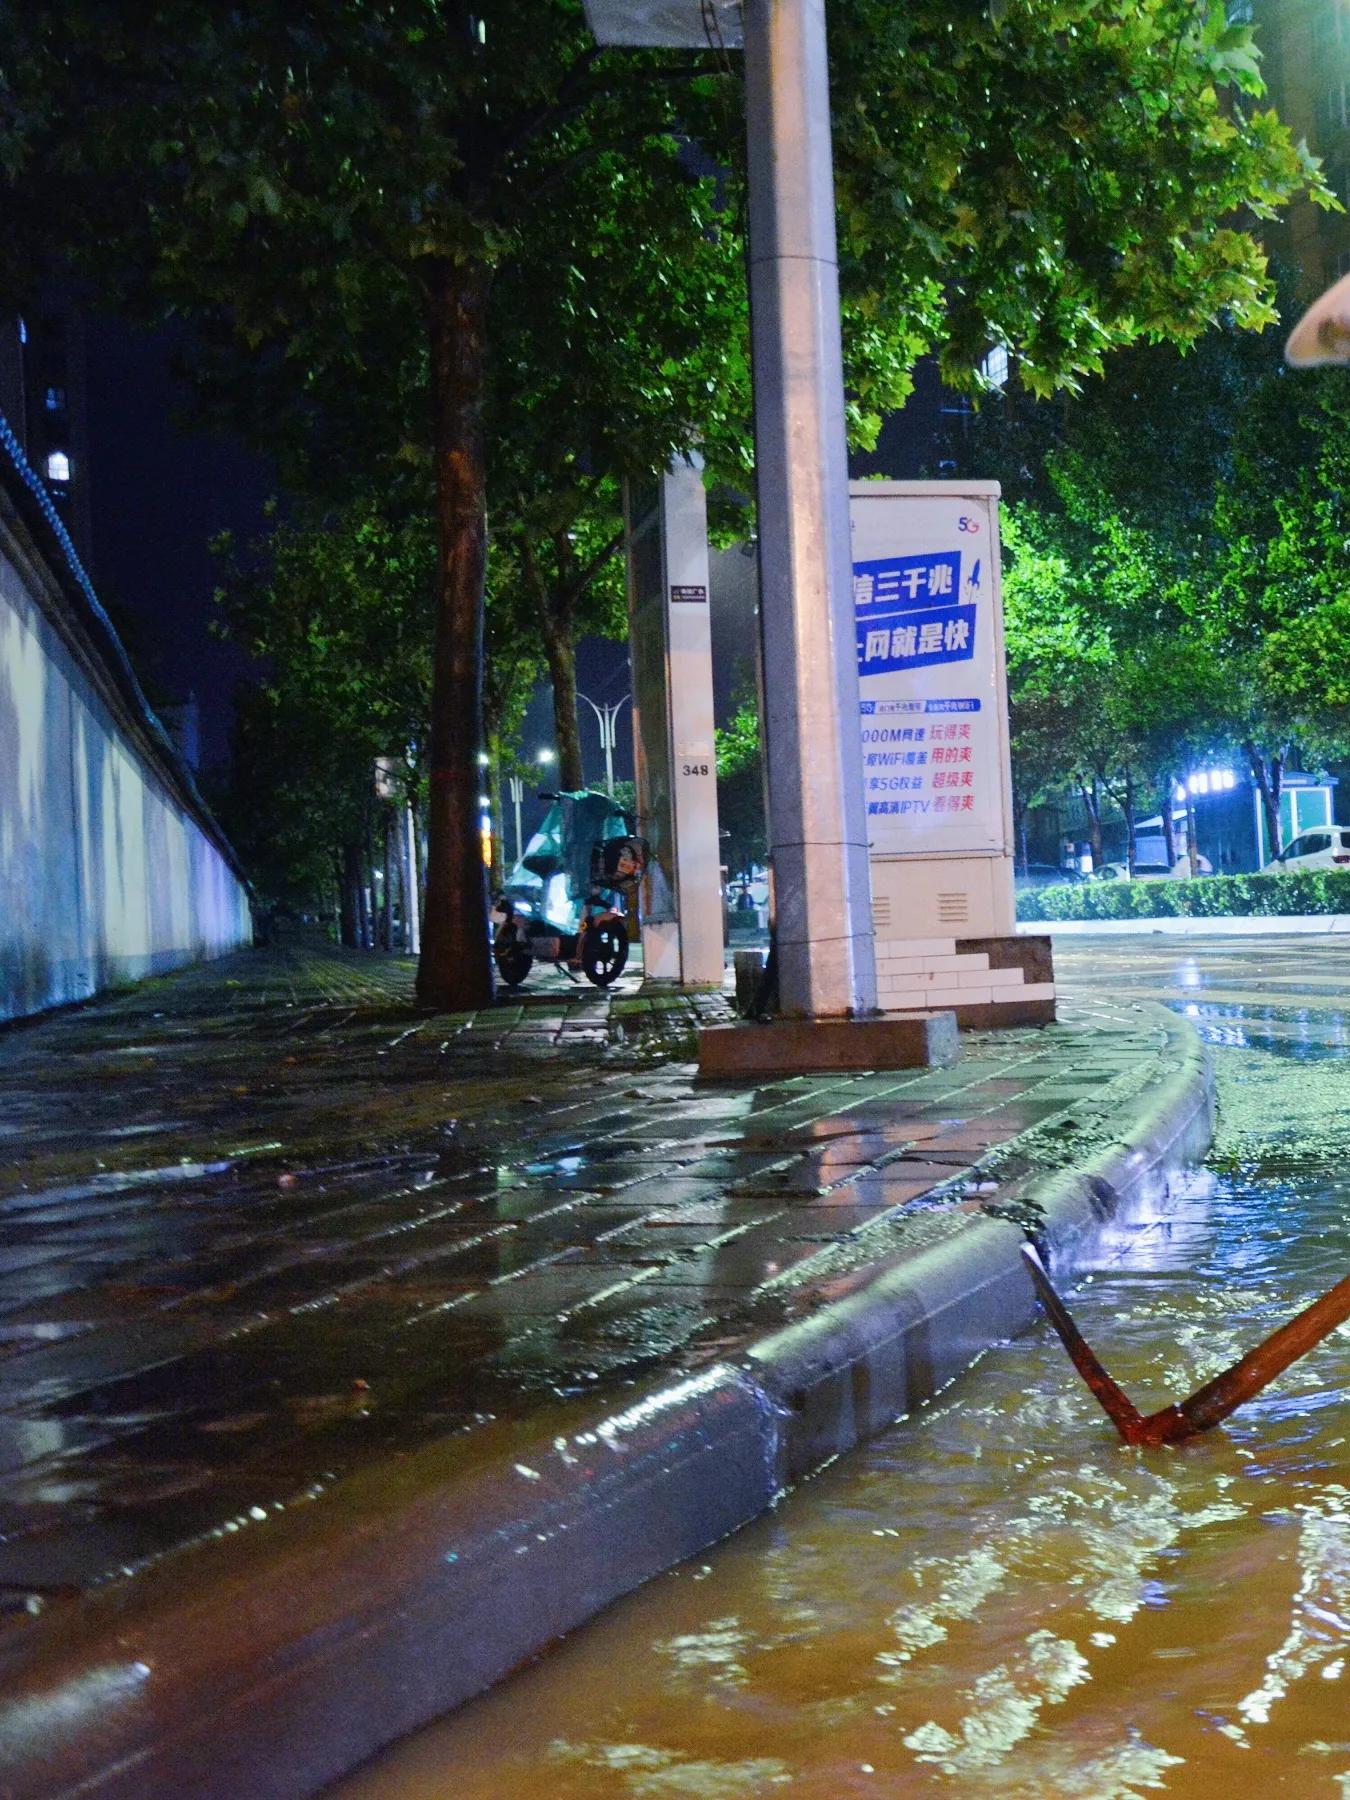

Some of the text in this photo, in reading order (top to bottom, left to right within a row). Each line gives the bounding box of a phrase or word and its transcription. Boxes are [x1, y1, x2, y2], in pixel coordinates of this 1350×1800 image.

[958, 516, 980, 533] 5G
[853, 564, 953, 605] 信三千兆
[682, 764, 709, 776] 348
